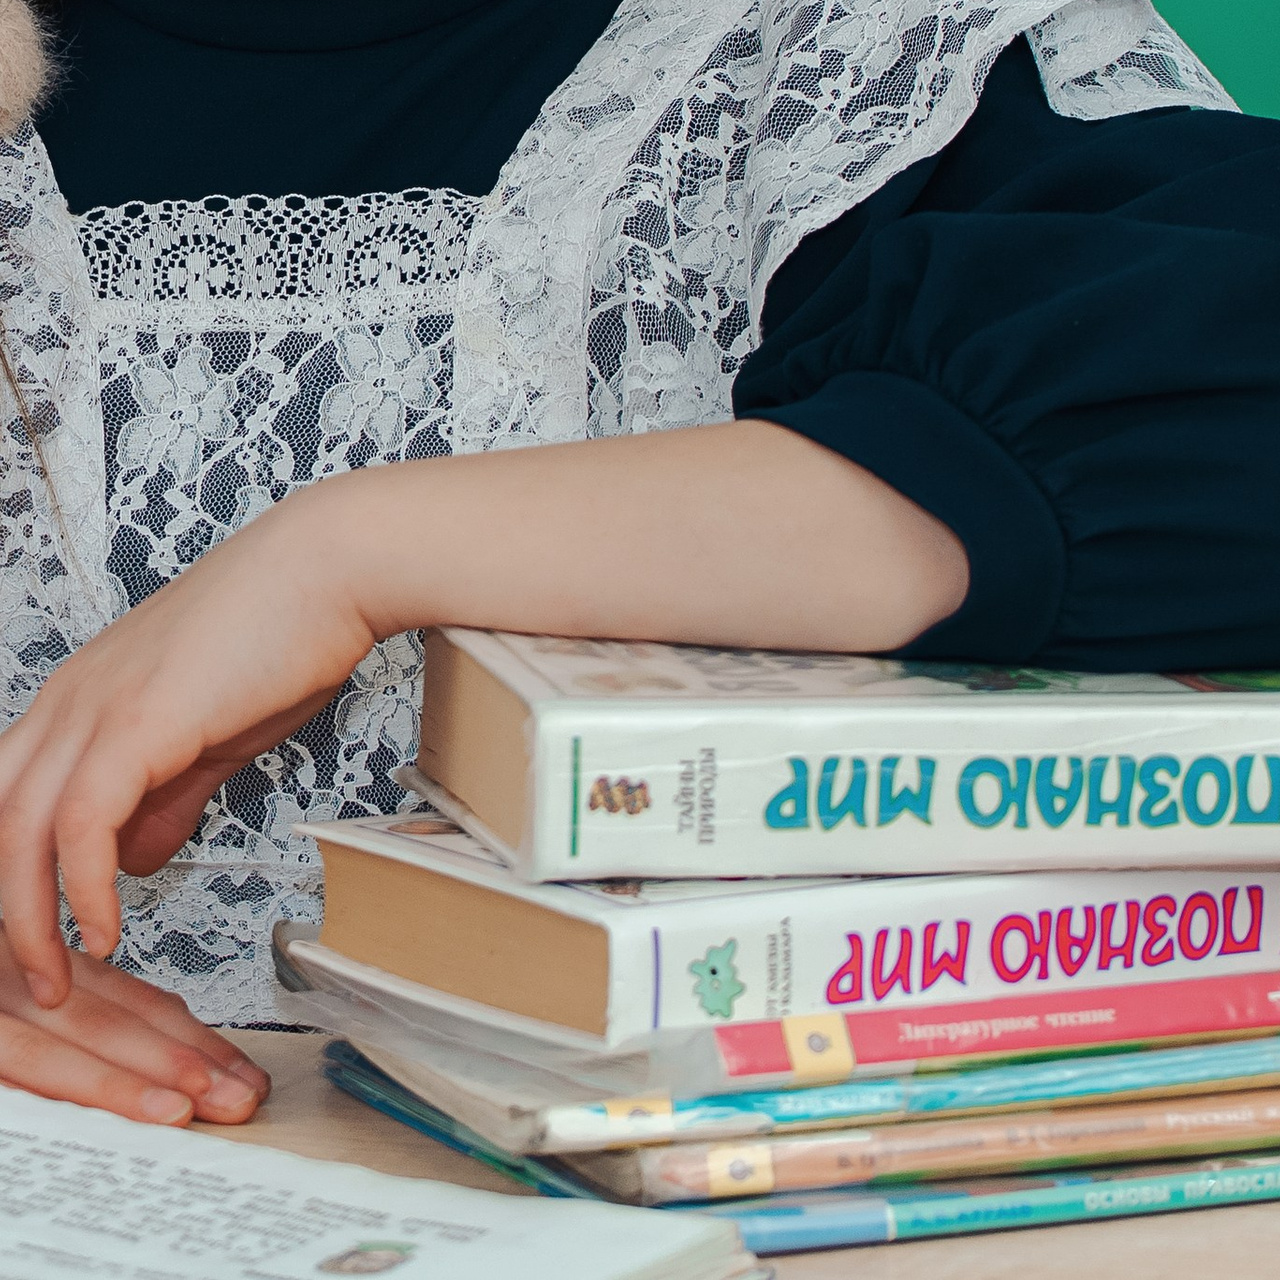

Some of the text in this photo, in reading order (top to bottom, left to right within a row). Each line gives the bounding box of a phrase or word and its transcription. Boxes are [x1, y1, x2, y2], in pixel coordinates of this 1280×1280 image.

[676, 759, 696, 835] ТАЙНЫ
[697, 748, 716, 845] ПРИРОДЫ
[764, 755, 1280, 832] ПОЗНАЮ МИР
[827, 885, 1264, 1005] ПОЗНАЮ МИР
[1044, 1007, 1116, 1029] чтение
[1084, 1184, 1170, 1212] ОСНОВЫ
